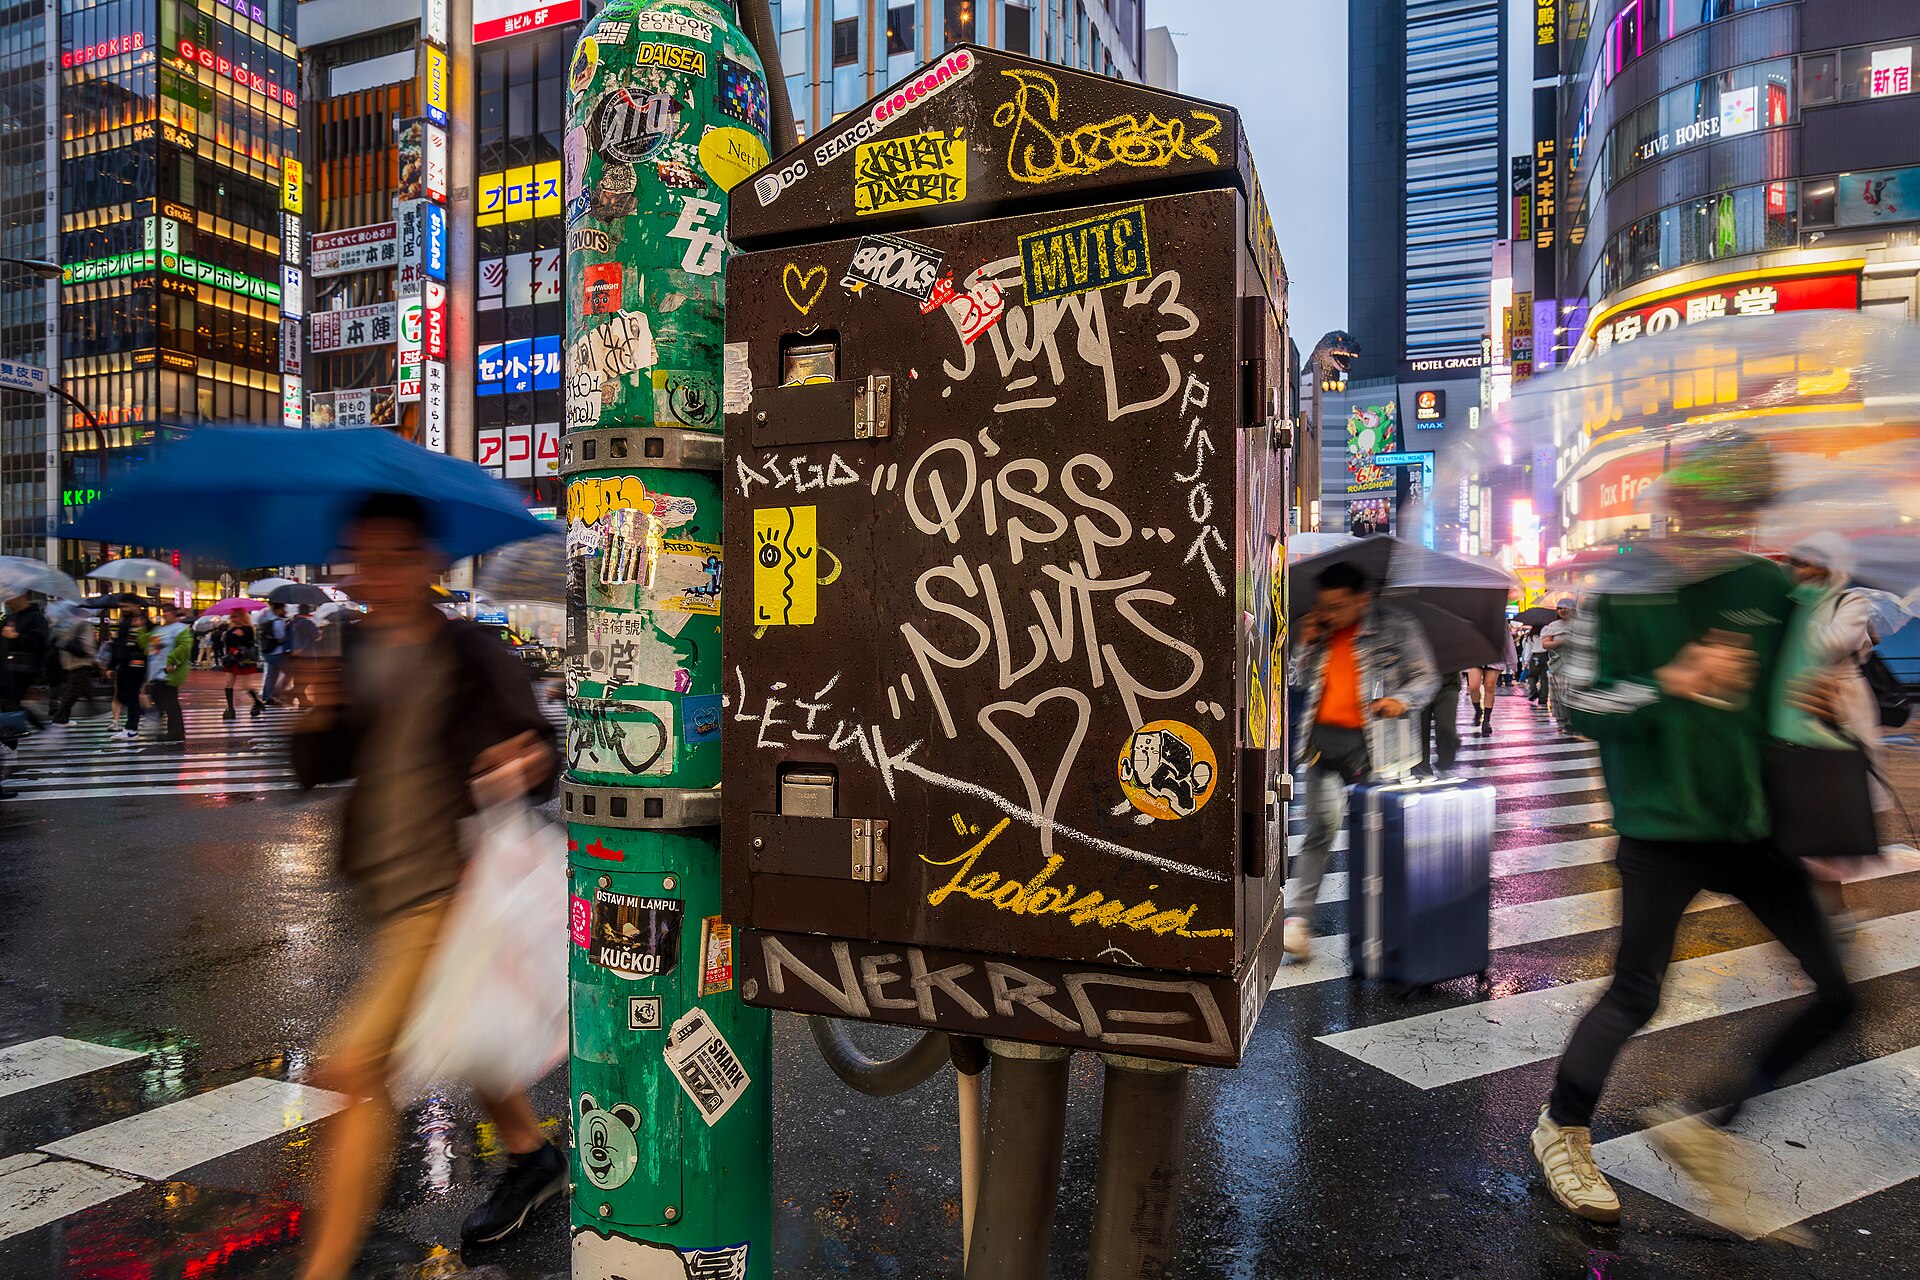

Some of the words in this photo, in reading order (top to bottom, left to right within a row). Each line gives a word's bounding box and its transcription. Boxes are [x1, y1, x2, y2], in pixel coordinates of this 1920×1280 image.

[220, 0, 264, 24] AR
[505, 15, 531, 32] 当ビル
[535, 9, 548, 24] 5F
[641, 22, 711, 42] COFFEE
[61, 32, 144, 69] GGPOKER
[639, 43, 704, 77] DAISEA
[180, 39, 297, 107] GGPOKER
[874, 51, 971, 122] croccante
[1873, 65, 1911, 95] 新宿
[430, 107, 443, 121] 6F
[1643, 134, 1669, 160] LIVE
[1675, 115, 1720, 146] HOUSE
[782, 161, 807, 184] DO
[486, 179, 559, 209] プロミス
[165, 221, 174, 248] ダーツ
[366, 243, 395, 268] 本陣
[854, 247, 936, 290] BROKS
[585, 283, 620, 293] HEAVYWEIGHT
[347, 316, 391, 345] 本陣
[430, 310, 441, 346] アコム
[431, 346, 441, 354] 3F
[1517, 352, 1531, 360] 4F
[479, 352, 561, 381] セントラル
[1412, 360, 1444, 371] HOTEL
[516, 381, 526, 391] 4F
[1417, 422, 1443, 430] IMAX
[480, 431, 559, 465] アコム
[63, 489, 101, 506] KKP
[596, 889, 625, 905] OSTAVI
[627, 897, 638, 908] MI
[600, 946, 661, 973] KUČKO!
[708, 1038, 745, 1090] SHARK
